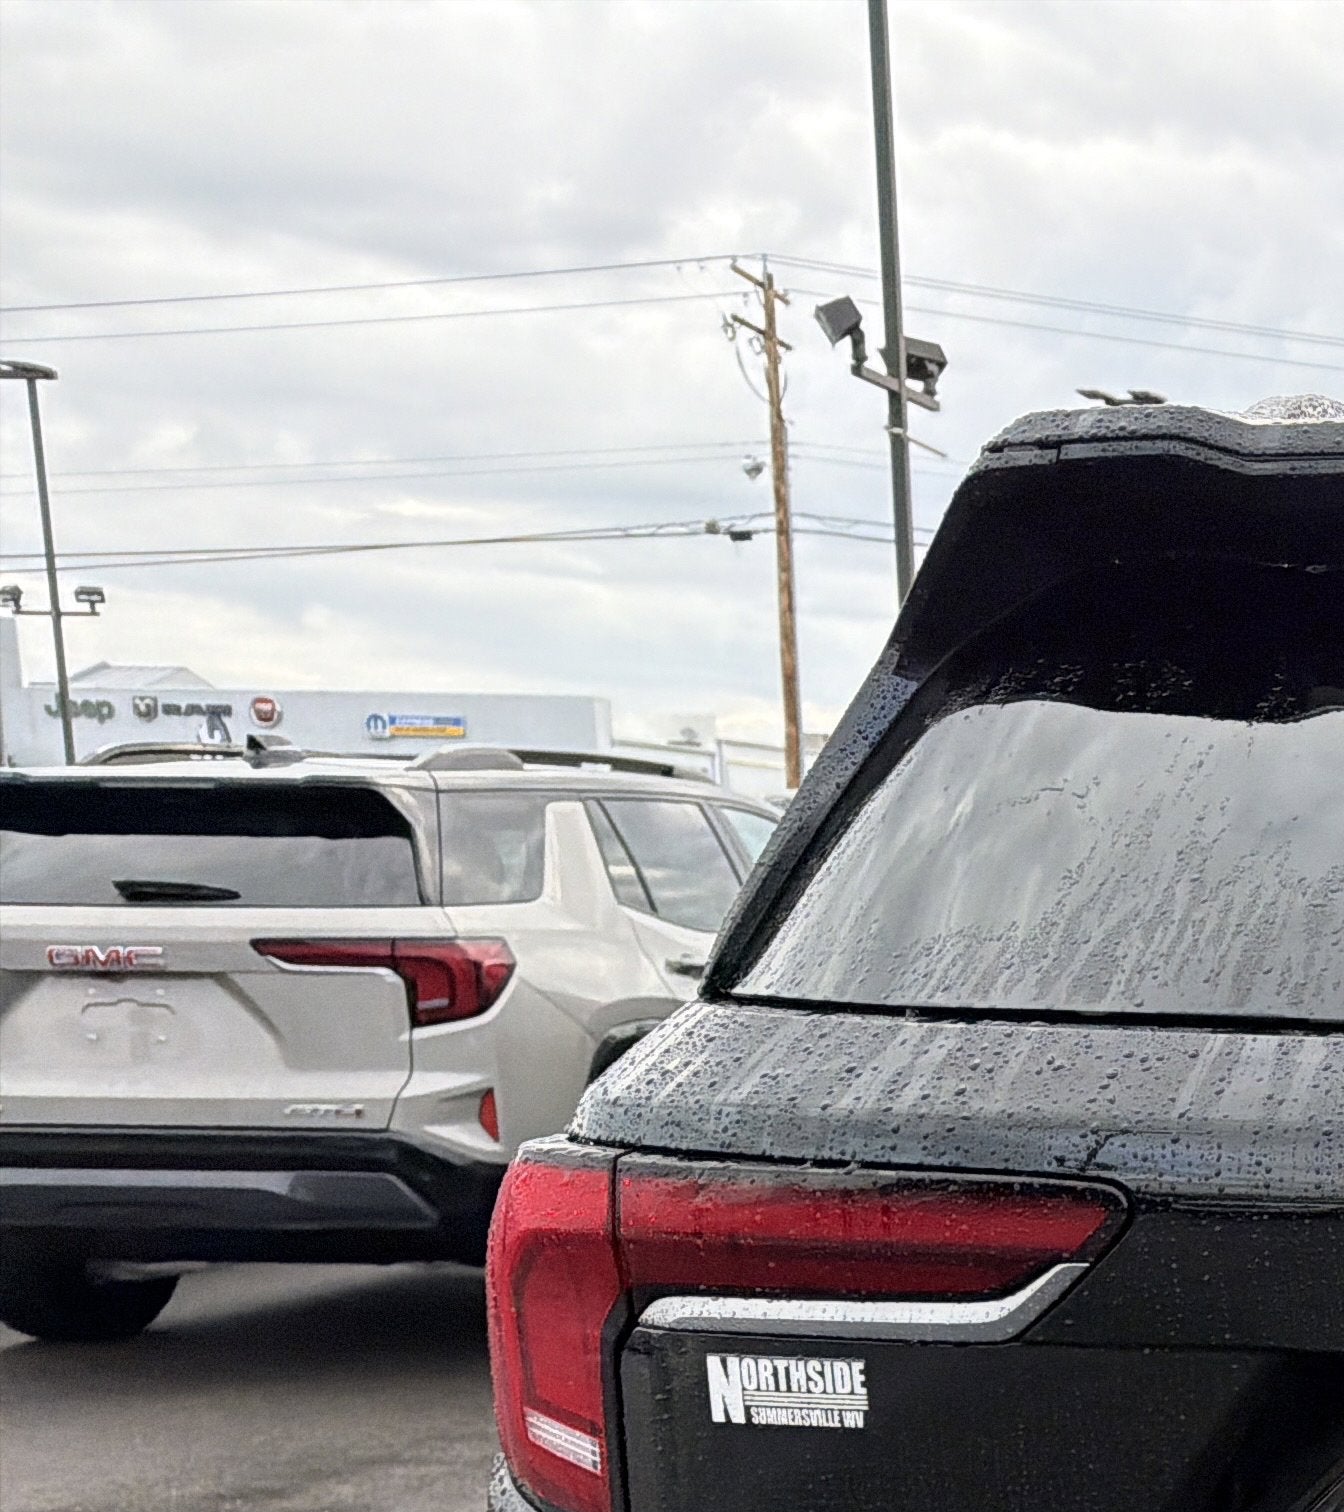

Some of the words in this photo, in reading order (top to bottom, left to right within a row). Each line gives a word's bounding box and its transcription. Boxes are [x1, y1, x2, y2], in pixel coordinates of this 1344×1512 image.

[46, 945, 165, 969] GMC
[706, 1355, 868, 1425] NORTHSIDE
[750, 1406, 842, 1428] SUMMERSVILLE
[842, 1410, 865, 1429] WV
